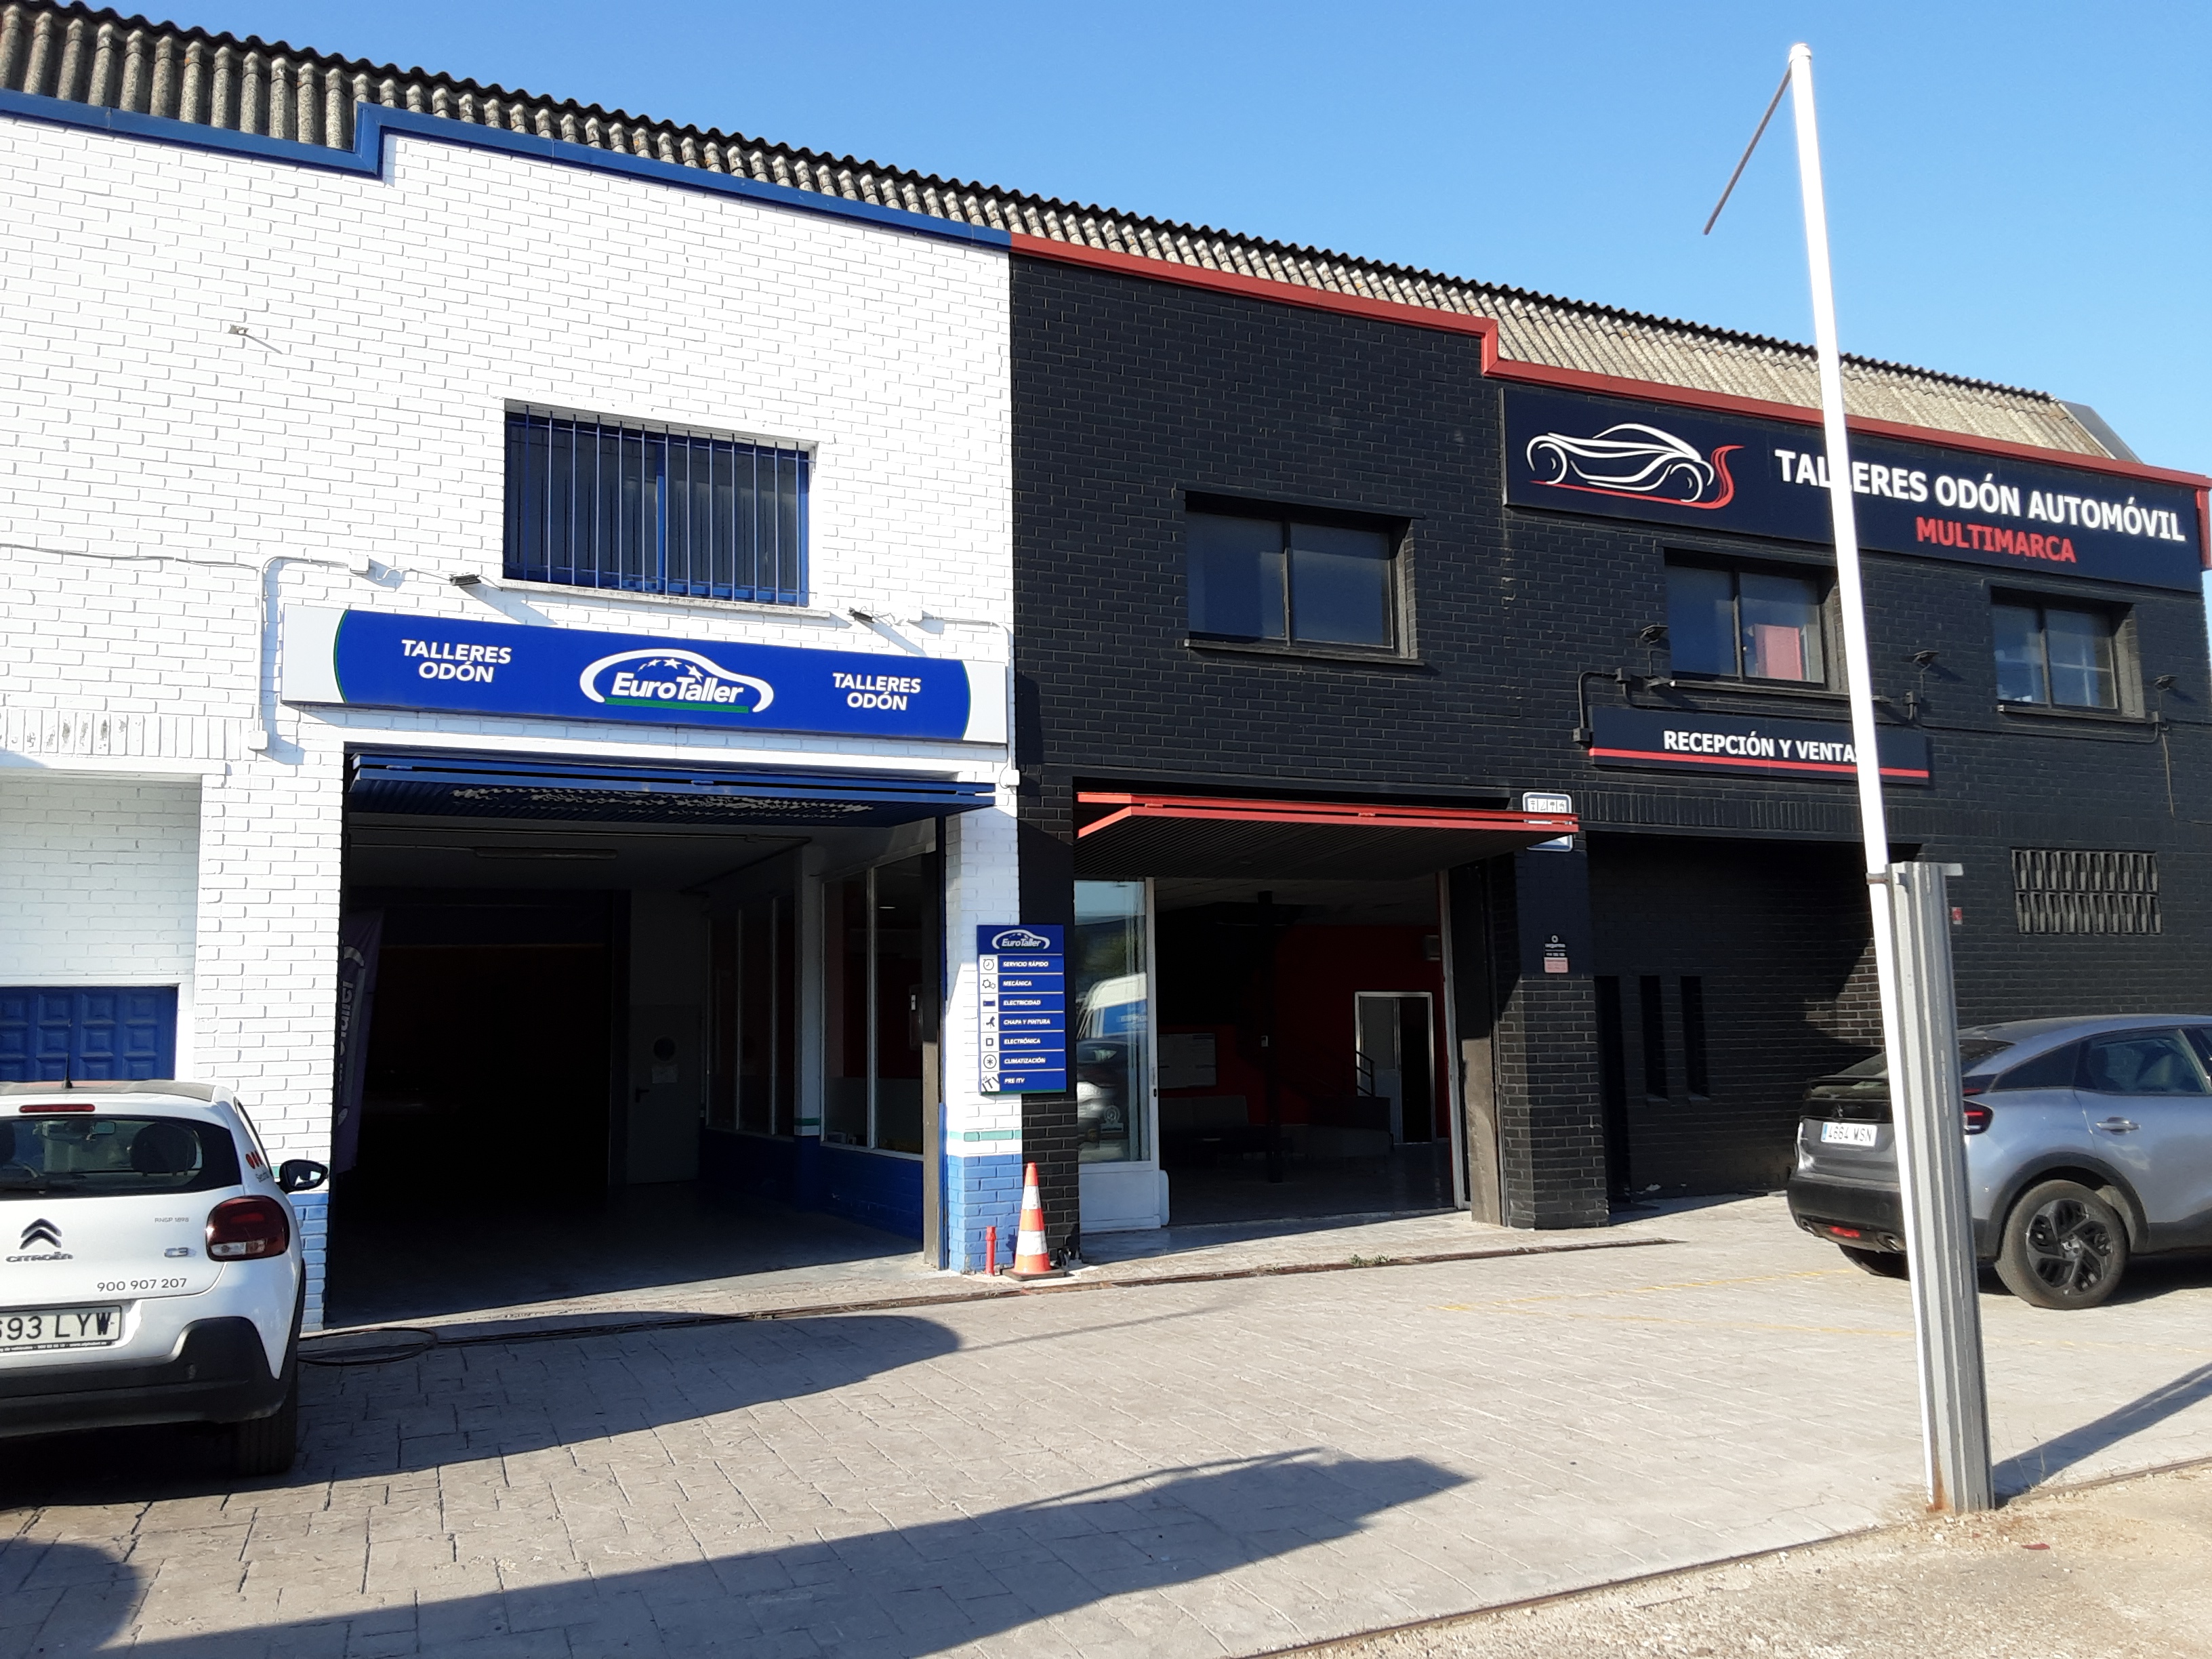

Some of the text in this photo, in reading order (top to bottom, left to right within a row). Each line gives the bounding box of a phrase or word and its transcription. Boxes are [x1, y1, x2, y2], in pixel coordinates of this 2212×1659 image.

[1774, 449, 2186, 542] TALERES ODÓN AUTOMÓVIL
[1916, 516, 2076, 563] MULTIMARCA
[401, 639, 512, 664] TALLERES
[418, 661, 495, 683] ODÓN
[832, 672, 922, 693] TALLERES
[611, 672, 744, 703] EuroTaller
[846, 691, 907, 711] ODÓN
[1663, 730, 1857, 763] RECEPCIÓN Y VENTA
[1002, 938, 1042, 947] EuroTaller
[164, 1247, 188, 1258] C3
[97, 1277, 187, 1292] 900 907 207
[0, 1312, 112, 1340] 93 LYW
